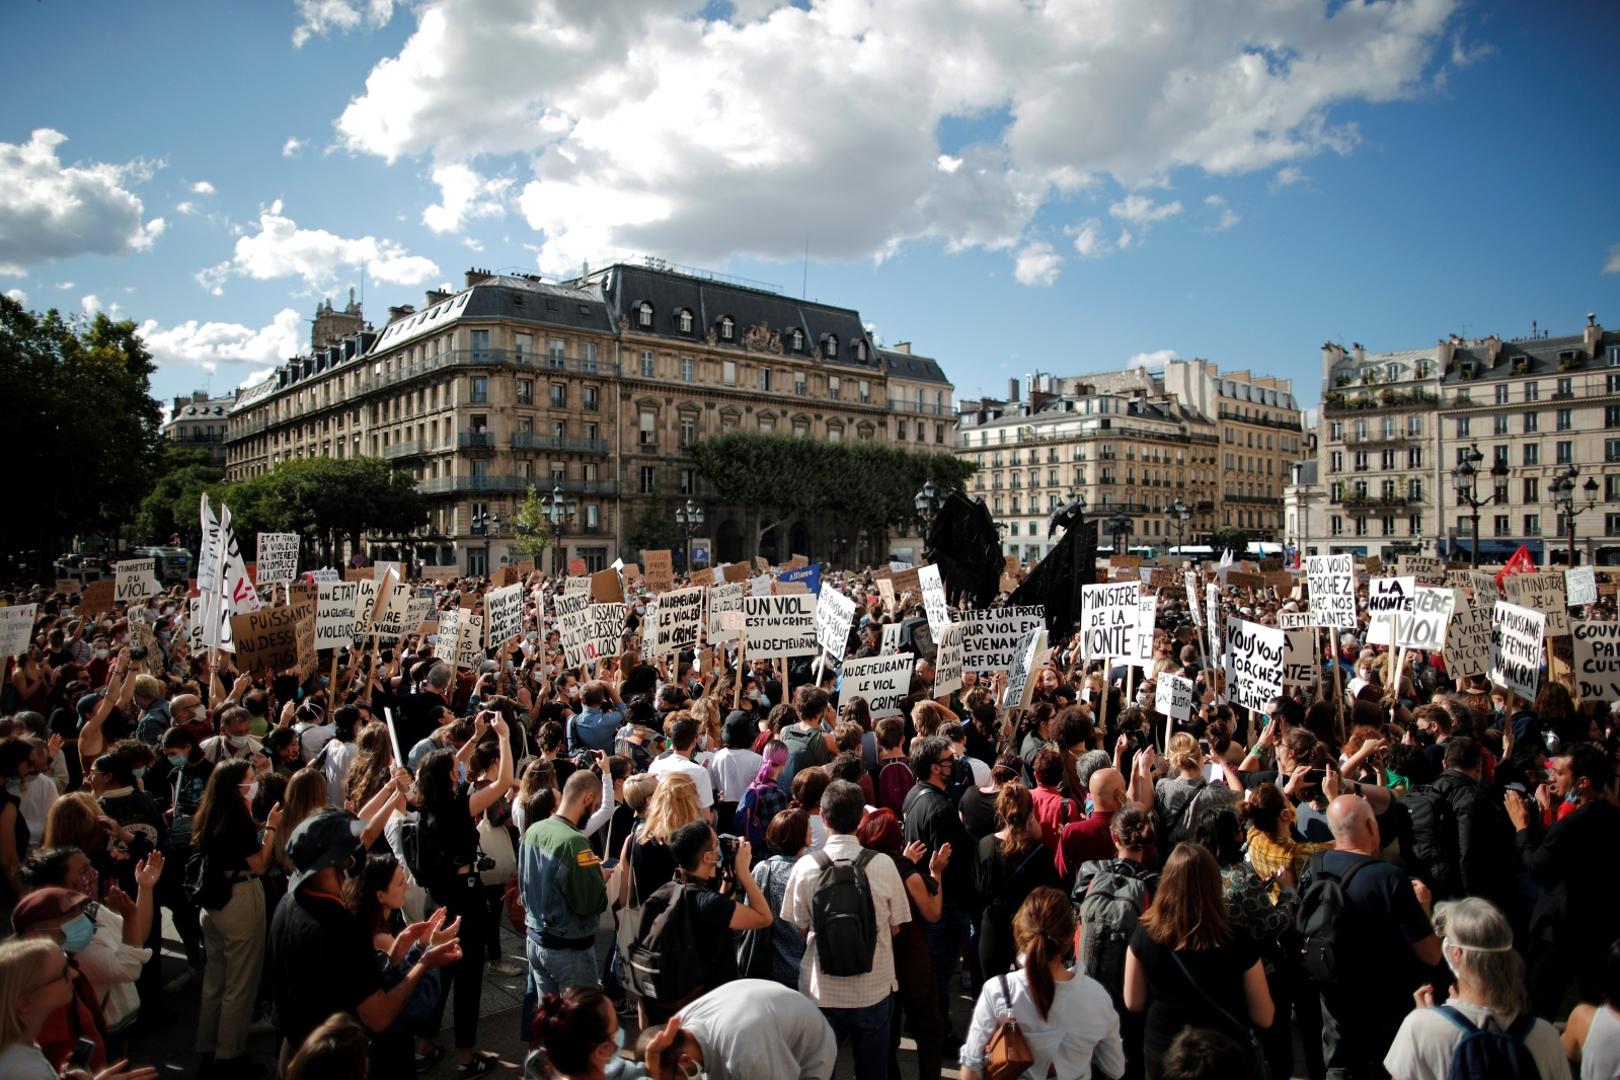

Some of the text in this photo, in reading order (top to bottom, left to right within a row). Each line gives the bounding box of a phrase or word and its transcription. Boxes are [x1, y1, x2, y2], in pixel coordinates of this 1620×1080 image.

[270, 543, 298, 551] VIOLEUR
[697, 549, 703, 559] P
[266, 560, 295, 570] COMPLICE
[1307, 556, 1351, 574] VOUS VOUS
[1406, 565, 1433, 573] VIRER
[128, 575, 140, 583] DU
[271, 569, 293, 581] JUSTICE
[118, 582, 151, 598] VIOL
[320, 592, 330, 600] UN
[333, 584, 356, 601] ETAT
[1308, 575, 1352, 596] TORCHEZ
[1378, 580, 1404, 596] LA
[490, 594, 506, 610] VOUS
[1083, 585, 1138, 610] MINISTERE
[1310, 597, 1353, 610] AVEC NOS
[1369, 596, 1416, 612] HONTE
[1531, 595, 1555, 608] DE LA
[323, 609, 330, 618] LA
[491, 603, 522, 622] TORCHEZ
[746, 597, 811, 616] UN VIOL
[996, 607, 1013, 619] UN
[564, 612, 587, 630] PAR LA
[660, 613, 671, 627] LE
[674, 607, 690, 623] VIOL
[746, 617, 813, 627] EST UN CRIME
[1091, 610, 1125, 627] DE LA
[1311, 611, 1355, 627] PLAINTES
[1495, 608, 1505, 625] LA
[490, 619, 507, 634] AVEC
[594, 621, 622, 639] DESSUS
[658, 624, 698, 645] UN CRIME
[962, 621, 1040, 637] OUR VIOL EN
[1397, 614, 1442, 646] VIOL
[1574, 624, 1620, 640] GOUV
[491, 625, 521, 646] PLAINTES
[563, 625, 595, 648] CULTURE
[598, 637, 616, 656] LOIS
[827, 634, 844, 659] LOIS
[963, 637, 1018, 652] EVENAN
[1228, 626, 1283, 668] VOUS VOUS
[1492, 631, 1537, 665] DES FEMMES
[567, 648, 581, 667] DU
[962, 656, 985, 668] HEF
[987, 655, 1000, 667] DE
[1231, 652, 1283, 687] TORCHEZ
[1451, 660, 1482, 677] A LA
[1495, 654, 1534, 690] VAINCRA
[859, 679, 896, 691] LE VIOL
[1233, 676, 1254, 690] AVEC
[1579, 681, 1604, 698] DU
[870, 694, 907, 712] CRIME
